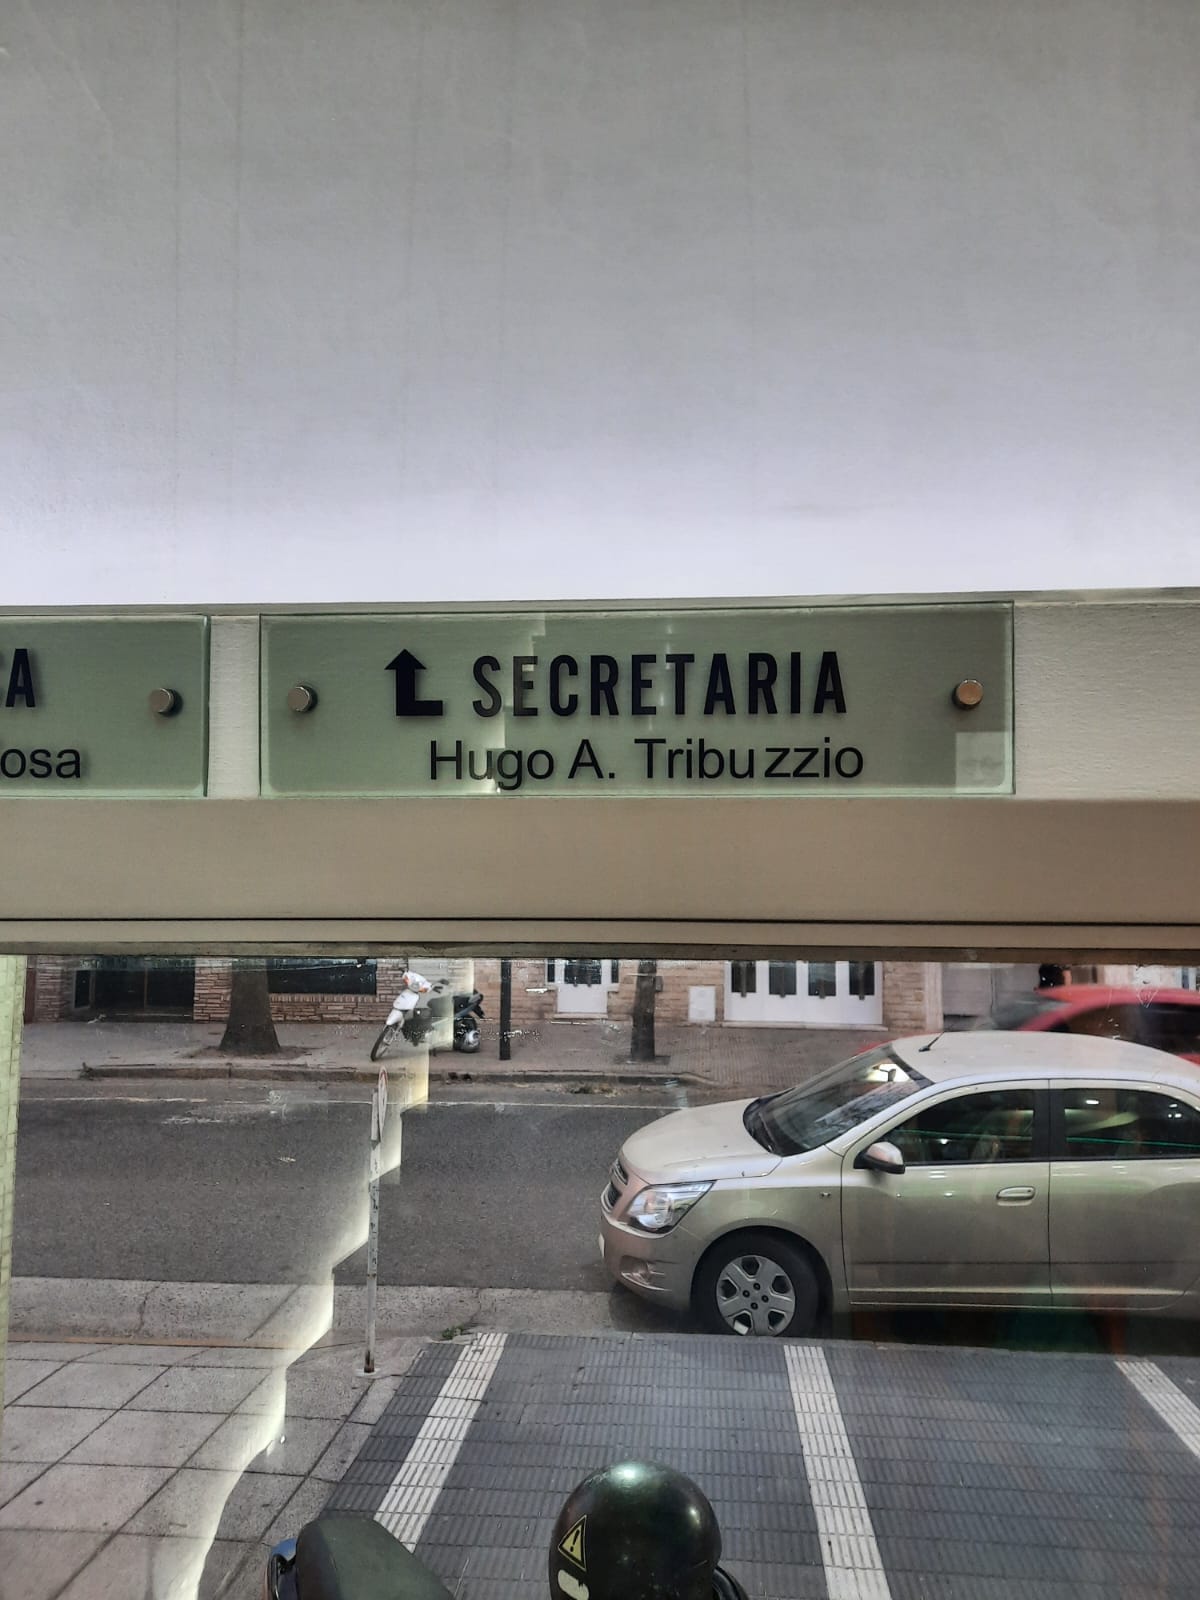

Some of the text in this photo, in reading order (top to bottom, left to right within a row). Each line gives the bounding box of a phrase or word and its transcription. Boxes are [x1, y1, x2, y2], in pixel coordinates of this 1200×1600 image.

[472, 651, 847, 718] SECRETARIA
[0, 748, 81, 779] osa
[430, 736, 864, 791] Hugo A. Tribuzzio
